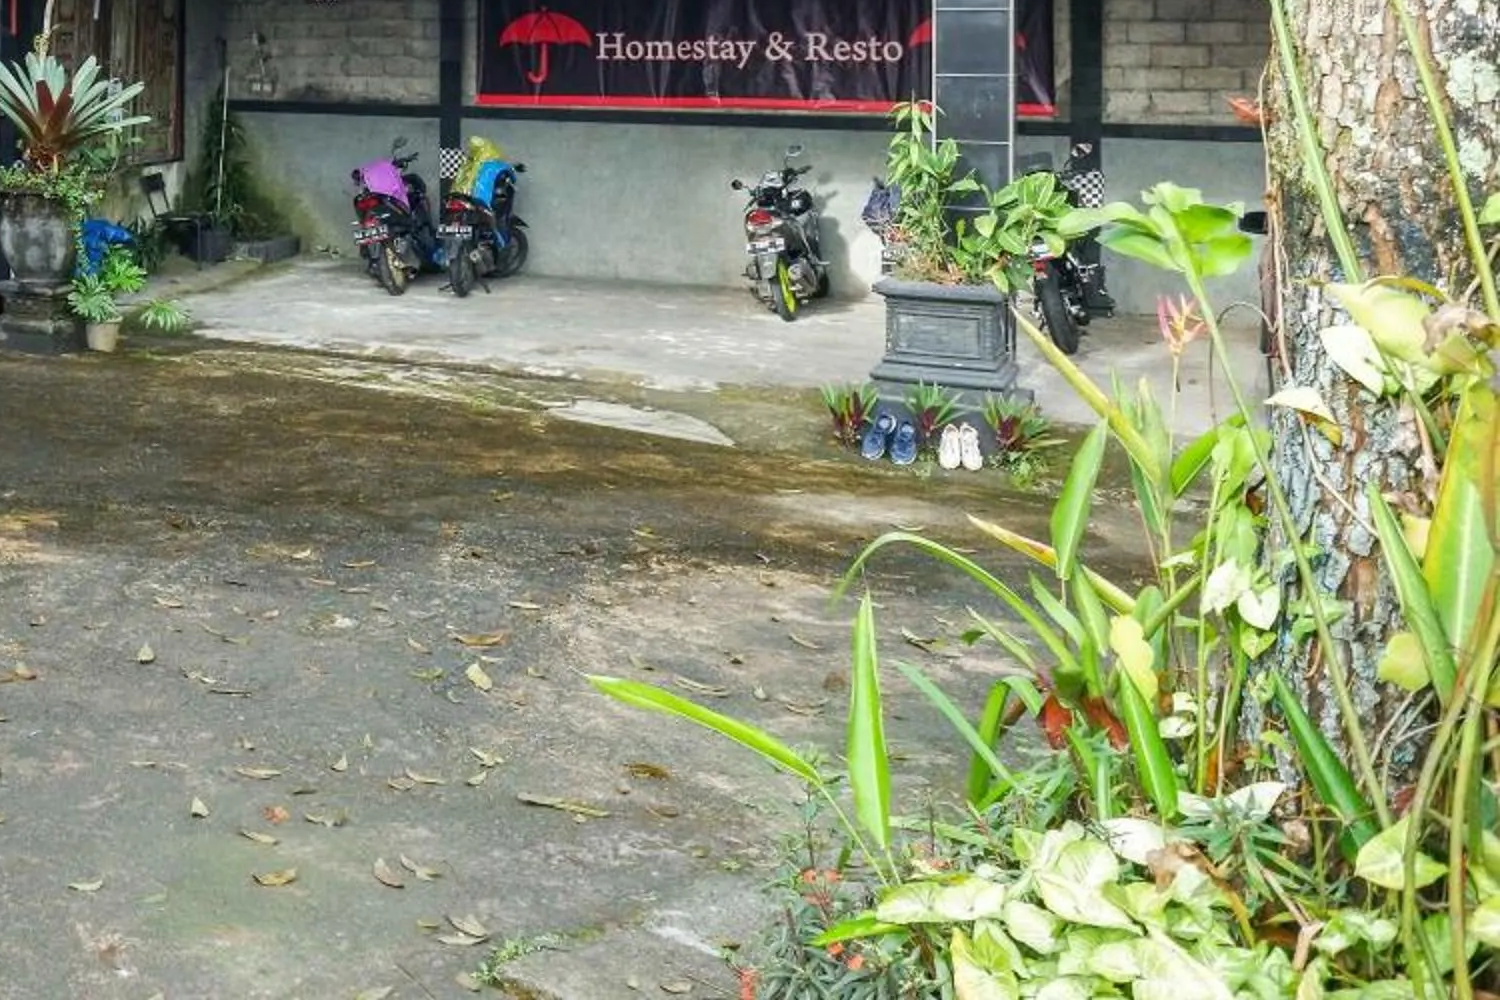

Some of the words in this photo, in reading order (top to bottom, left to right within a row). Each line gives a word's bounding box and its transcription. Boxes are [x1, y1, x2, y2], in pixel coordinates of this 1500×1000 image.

[596, 32, 756, 69] Homestay
[765, 31, 795, 62] &
[804, 32, 903, 61] Resto
